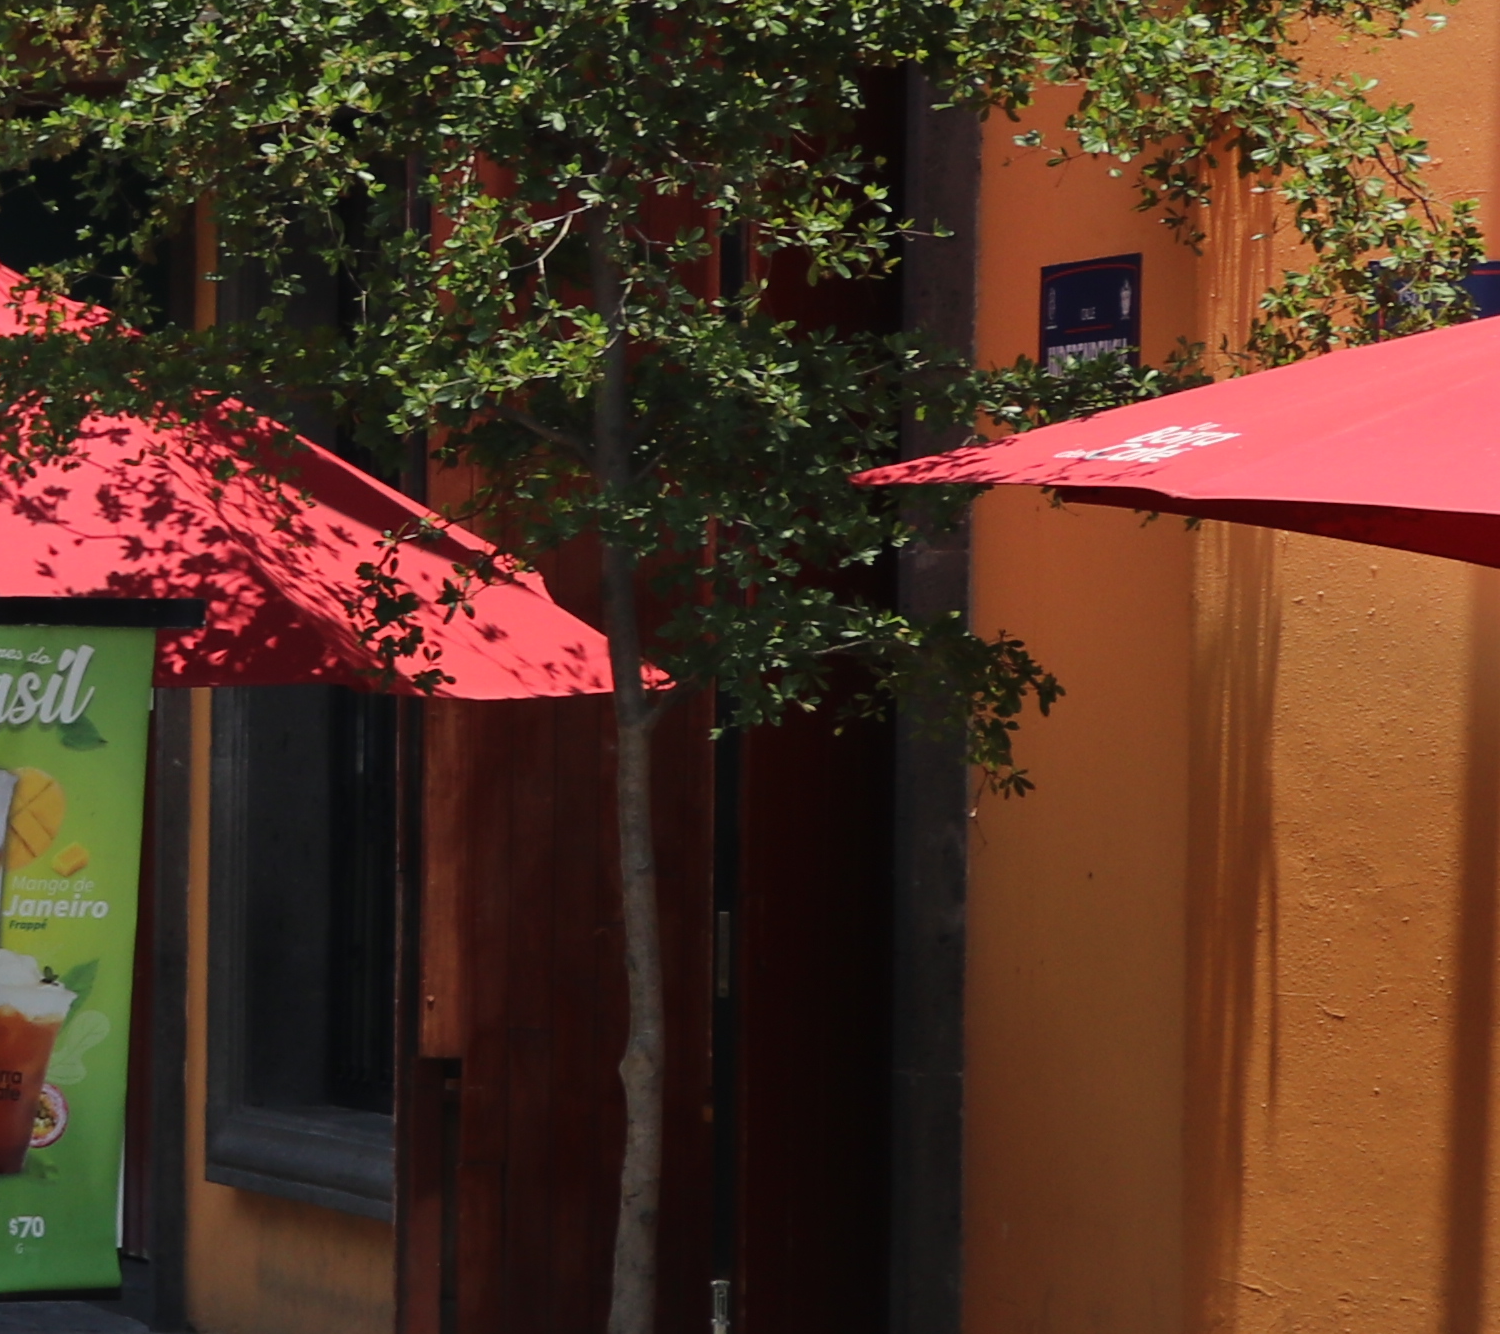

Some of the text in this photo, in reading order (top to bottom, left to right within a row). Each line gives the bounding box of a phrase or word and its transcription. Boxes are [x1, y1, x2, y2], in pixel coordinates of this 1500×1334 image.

[1124, 426, 1242, 446] Borra
[11, 875, 96, 893] Mango de
[2, 893, 110, 919] Janeiro
[8, 919, 47, 931] Frappé
[9, 1216, 45, 1238] $70
